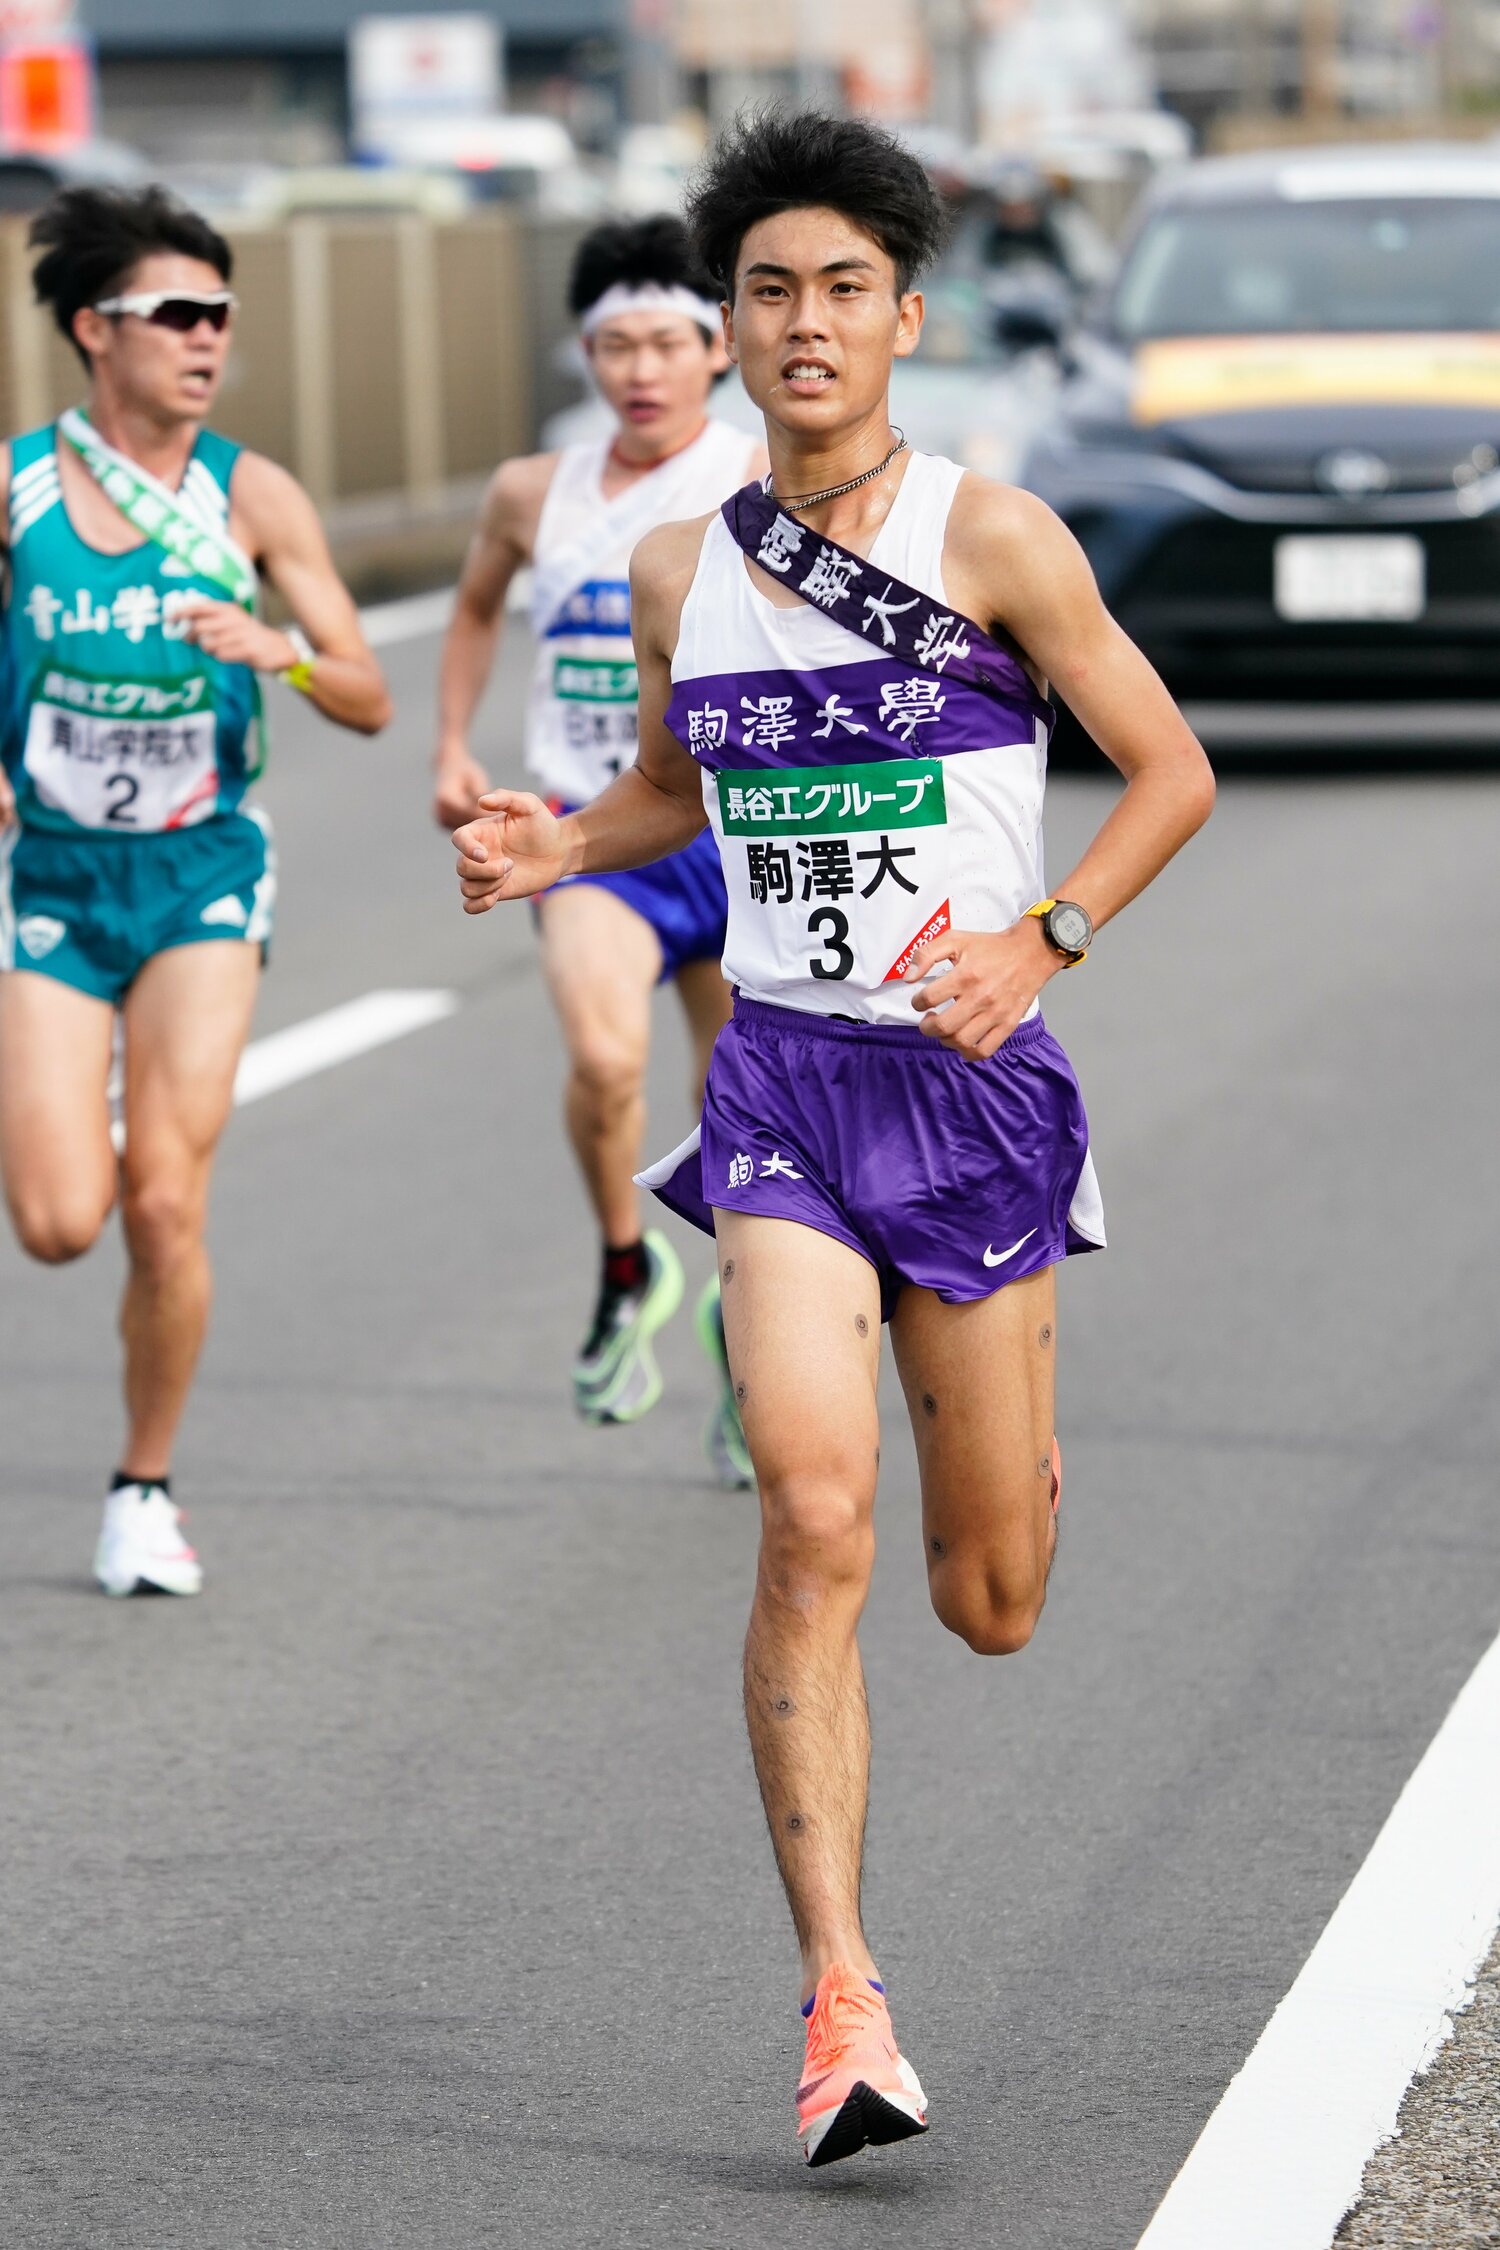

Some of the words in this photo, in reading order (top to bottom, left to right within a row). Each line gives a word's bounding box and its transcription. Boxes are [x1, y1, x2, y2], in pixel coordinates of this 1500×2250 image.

[687, 676, 947, 755] 駒澤大學
[104, 772, 140, 823] 2
[727, 774, 933, 821] 長谷工グループ
[746, 835, 920, 905] 駒澤大
[807, 906, 854, 981] 3
[726, 1151, 804, 1189] 駒大
